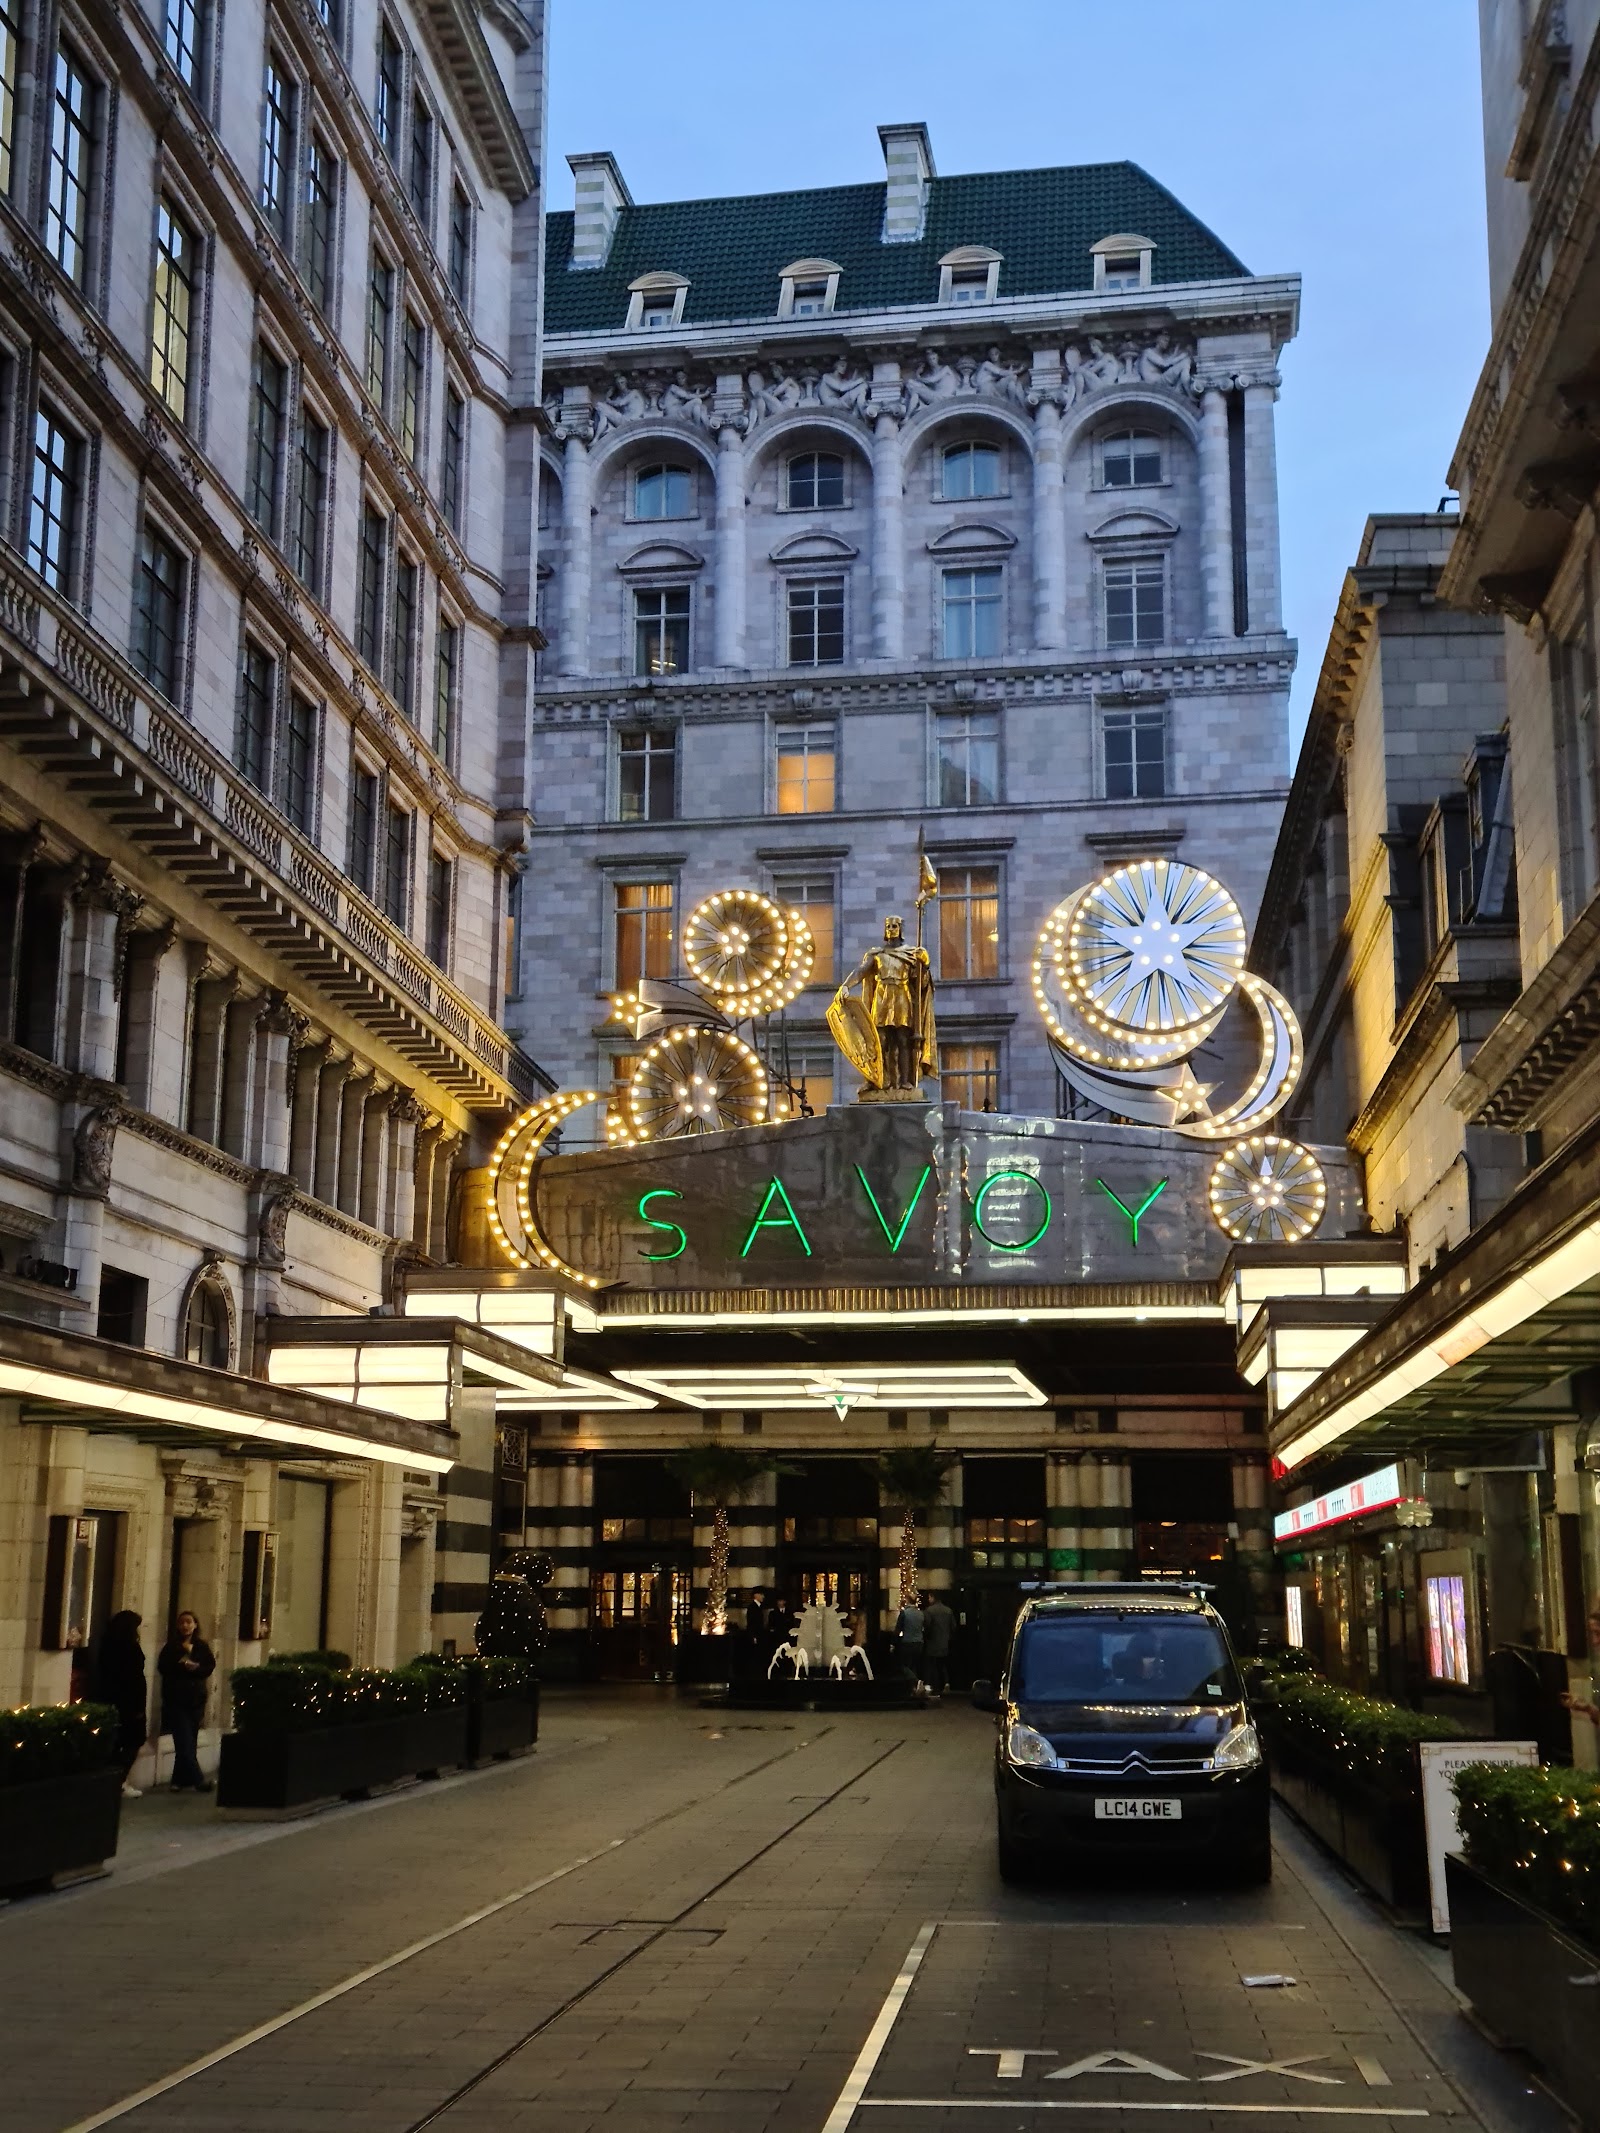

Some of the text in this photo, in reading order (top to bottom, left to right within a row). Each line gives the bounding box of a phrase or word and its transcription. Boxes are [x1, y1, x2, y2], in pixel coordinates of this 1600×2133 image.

[639, 1163, 1170, 1261] SAVOY
[1104, 1801, 1172, 1817] LC14 GWE
[967, 2048, 1394, 2087] TAXI
